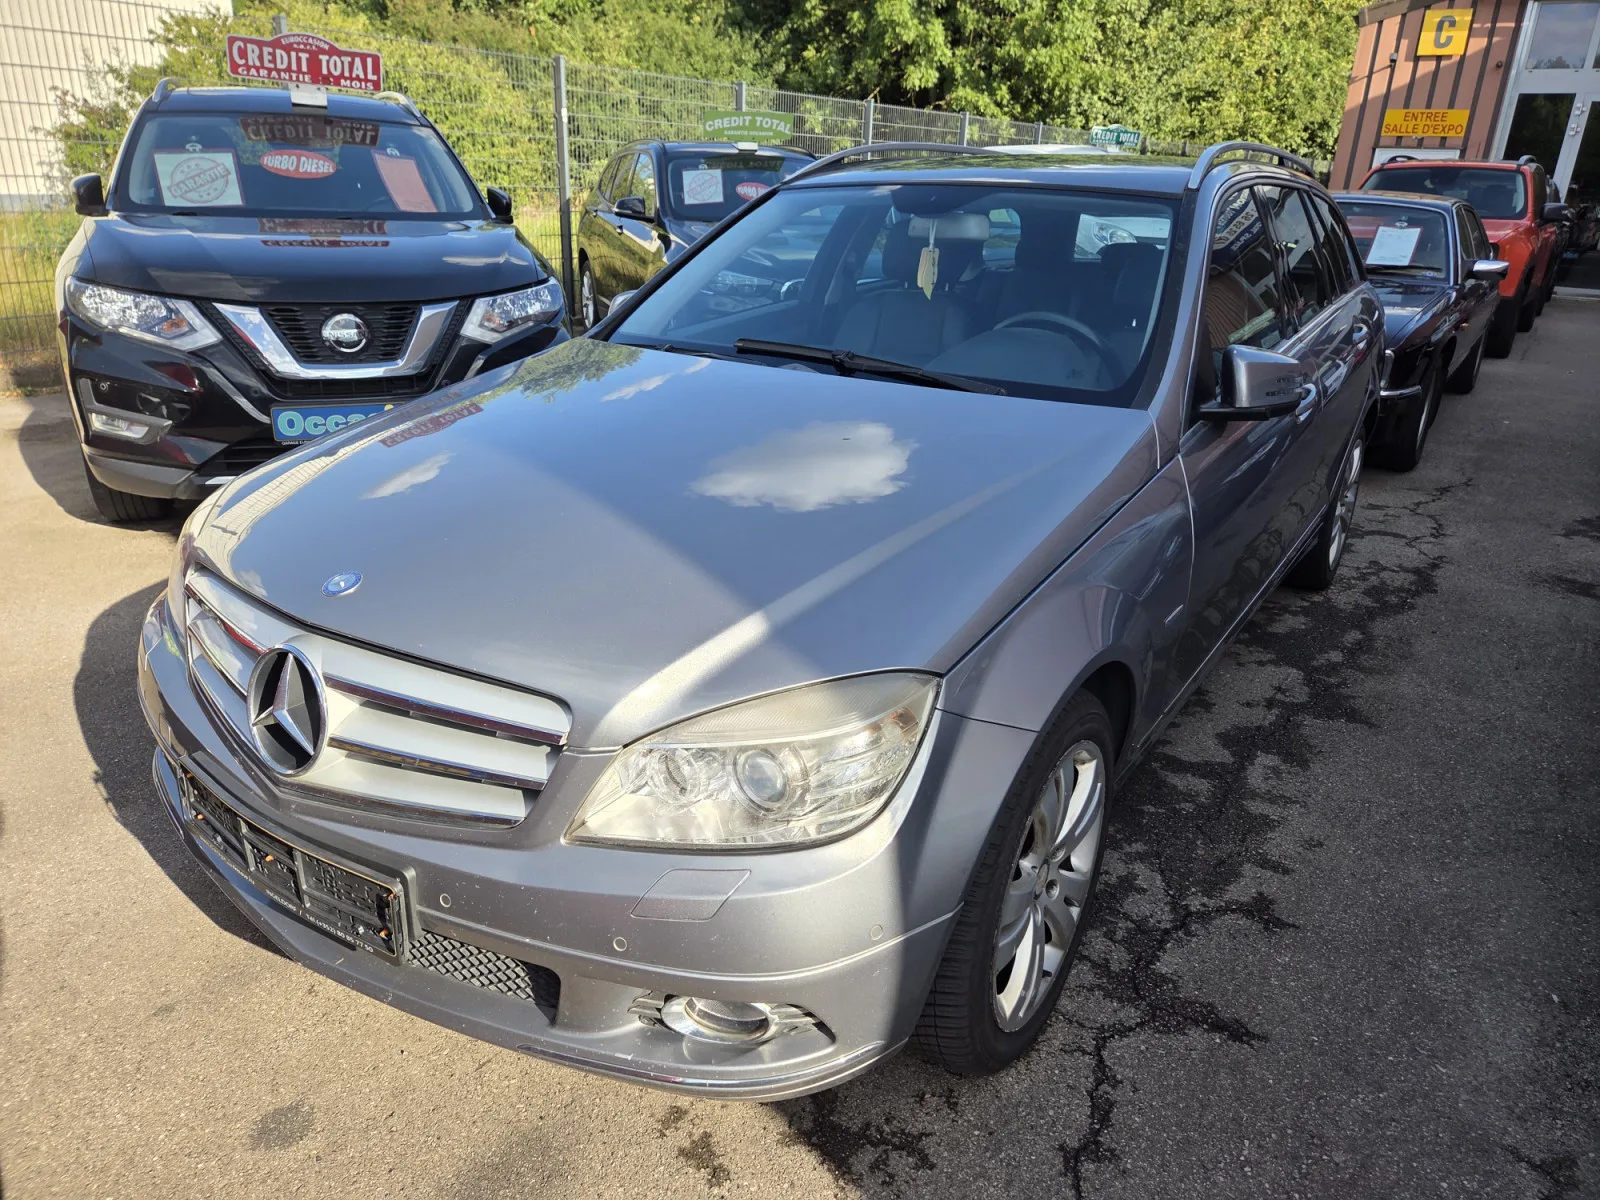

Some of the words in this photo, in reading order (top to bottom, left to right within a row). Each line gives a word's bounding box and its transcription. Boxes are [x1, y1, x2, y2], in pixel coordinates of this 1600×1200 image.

[1433, 15, 1457, 49] C
[232, 40, 309, 73] CREDIT
[319, 54, 377, 81] TOTAL
[238, 67, 312, 83] GARANTIE
[340, 79, 374, 90] MOIS
[705, 115, 752, 132] CREDIT
[755, 116, 791, 135] TOTAL
[1403, 111, 1449, 122] ENTREE
[1093, 129, 1117, 141] CREDIT
[1119, 132, 1138, 143] TOTAL
[1383, 123, 1420, 134] SALLE
[1422, 123, 1464, 135] D'EXPO
[263, 155, 297, 171] TURBO
[299, 155, 335, 173] DIESEL
[169, 163, 229, 198] GARANTIE
[329, 331, 366, 340] NISSAN
